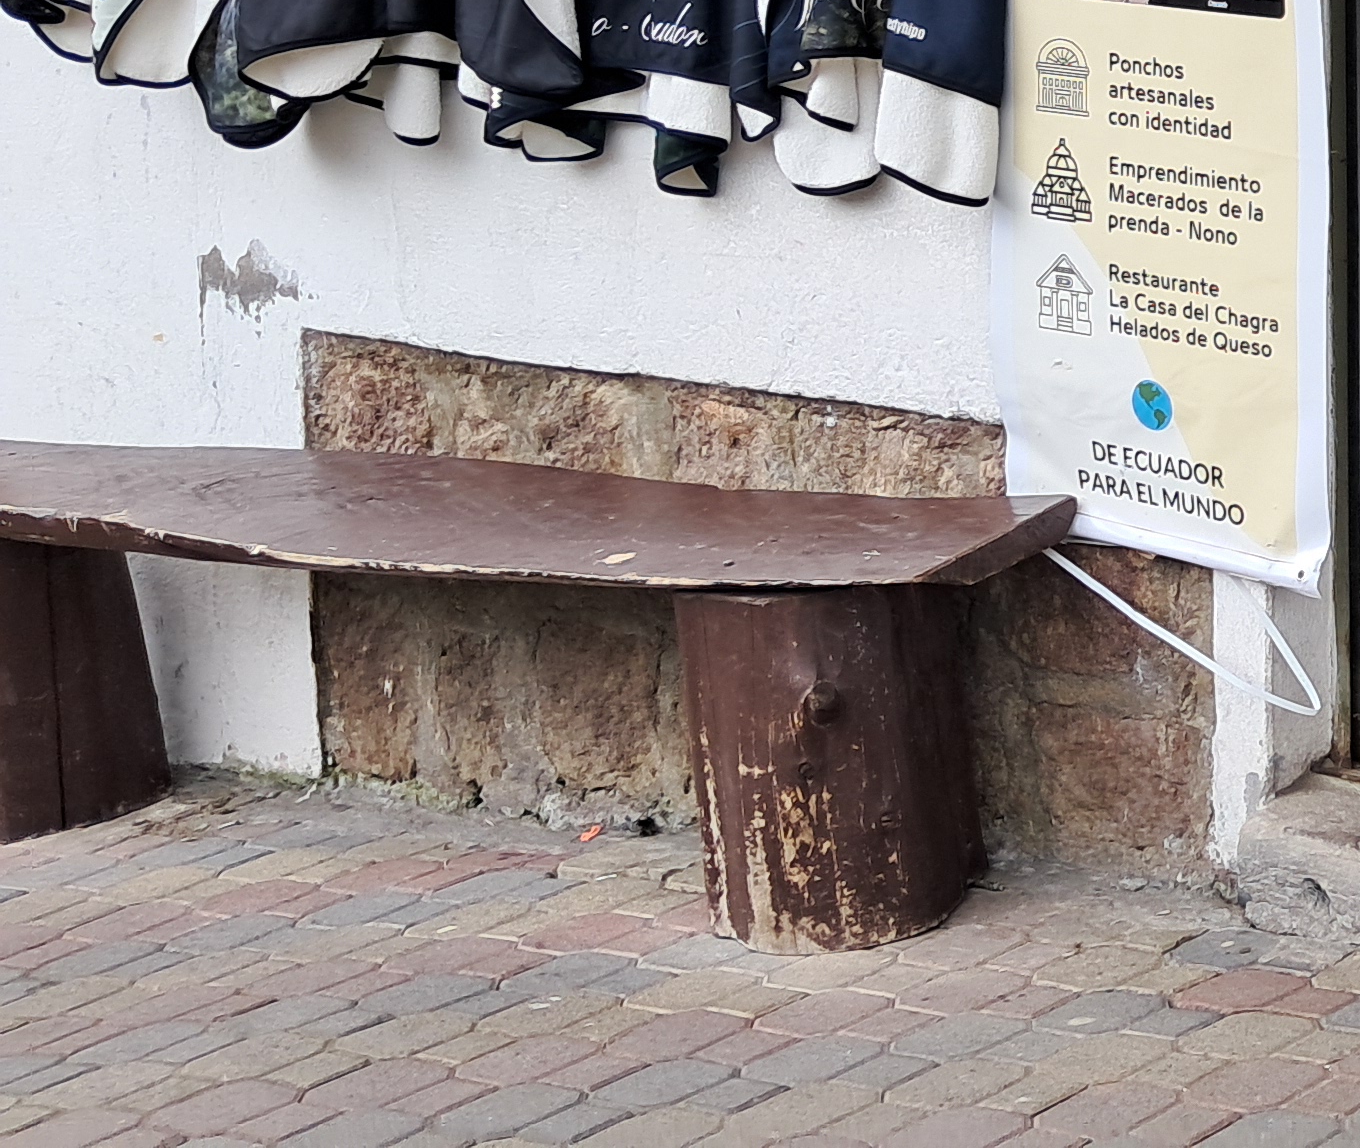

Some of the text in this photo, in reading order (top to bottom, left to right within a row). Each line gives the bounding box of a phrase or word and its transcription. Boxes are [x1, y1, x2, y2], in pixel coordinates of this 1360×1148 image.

[1109, 52, 1185, 80] Ponchos
[1108, 83, 1215, 111] artesanales
[1108, 110, 1232, 140] con identidad
[1109, 156, 1261, 194] Emprendimiento
[1109, 183, 1264, 222] Macerados de la
[1108, 214, 1238, 246] prenda Nono
[1109, 264, 1220, 298] Restaurante
[1109, 290, 1279, 334] La Casa del Chagra
[1109, 315, 1273, 358] Helados de Queso
[1091, 440, 1225, 489] DE ECUADOR
[1078, 469, 1245, 526] PARA EL MUNDO
